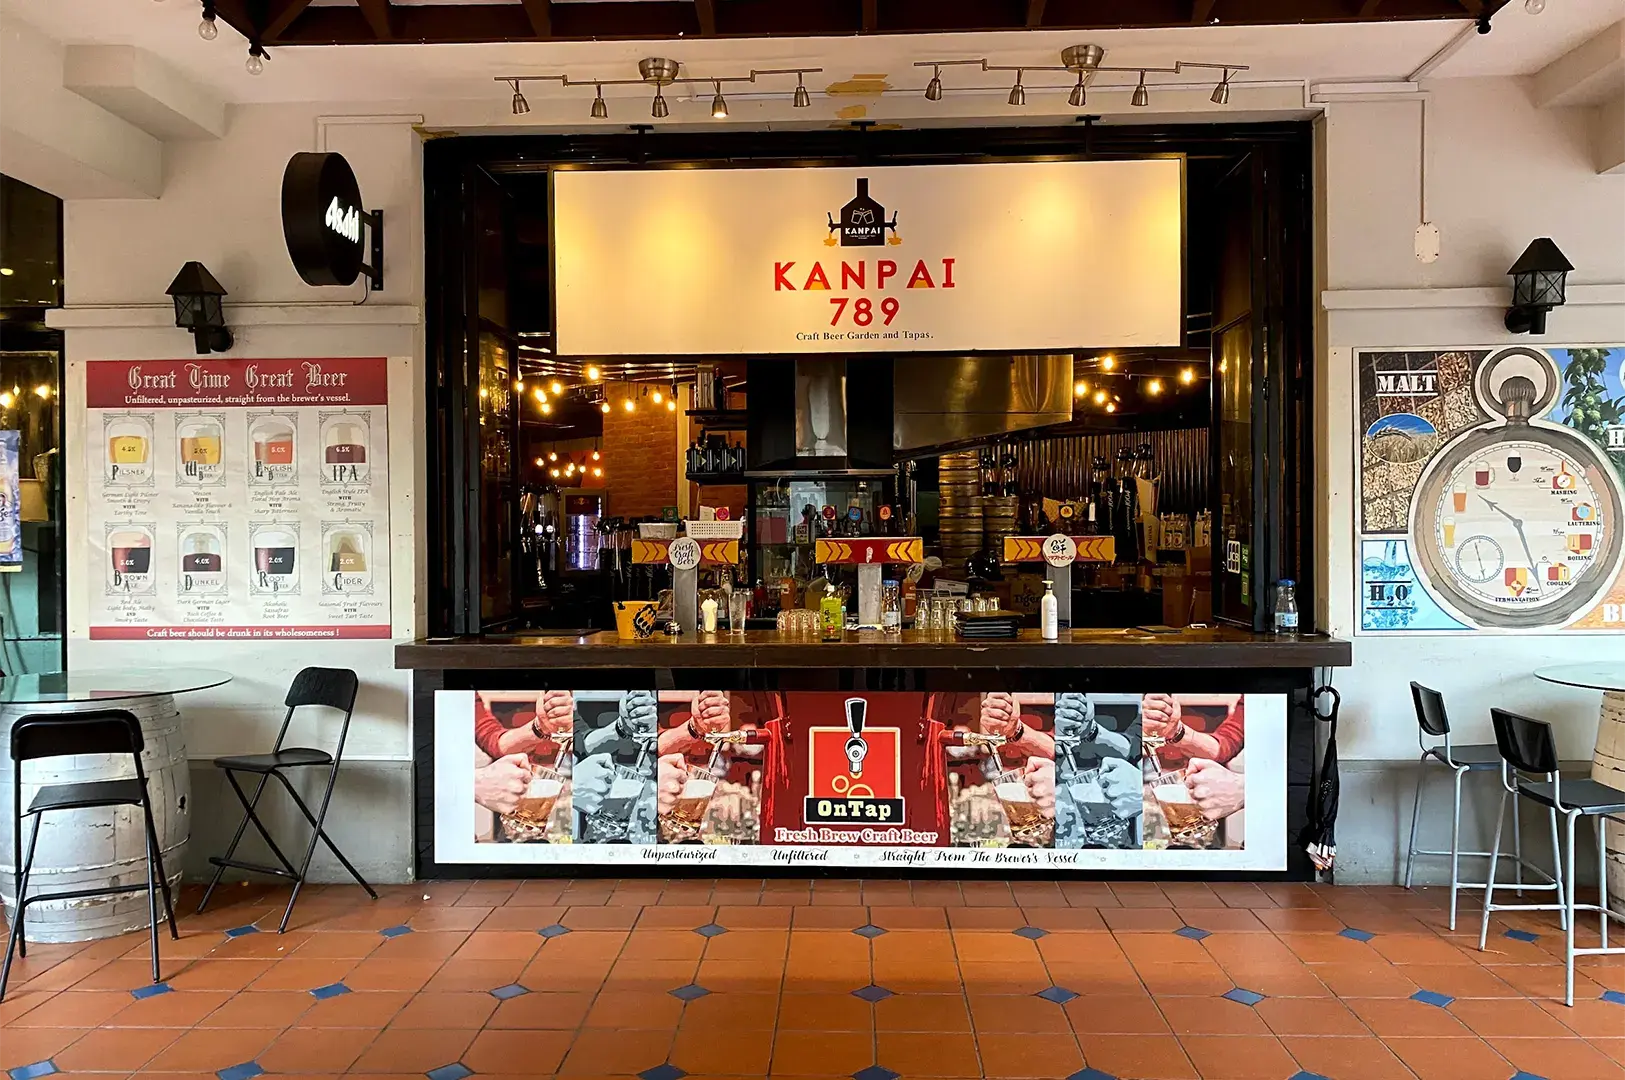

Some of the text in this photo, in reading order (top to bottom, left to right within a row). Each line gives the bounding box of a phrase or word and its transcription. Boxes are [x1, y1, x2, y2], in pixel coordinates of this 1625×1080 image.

[326, 196, 359, 244] Asahi
[844, 227, 880, 235] KANPAI
[774, 258, 956, 290] KANPAI
[830, 297, 900, 326] 789
[796, 330, 934, 341] Craft Beer Garden and Tapas.
[128, 362, 348, 394] Great Time Great Beer
[1378, 375, 1436, 392] MALT
[124, 392, 351, 406] Unfiltered, unpasteurized, straight from the brewer's vessel.
[333, 465, 358, 481] IPA
[673, 542, 694, 552] Fresh
[674, 549, 694, 561] Craft
[677, 557, 695, 566] Beer
[334, 572, 363, 591] CIDER
[146, 628, 168, 638] Craft
[170, 628, 187, 638] beer
[188, 628, 214, 638] should
[216, 628, 226, 638] be
[227, 628, 252, 637] drunk
[253, 628, 262, 637] in
[263, 628, 274, 637] its
[275, 628, 335, 637] wholesomeness
[817, 800, 892, 820] OnTap
[774, 827, 938, 844] Fresh Brew Craft Beer
[641, 848, 718, 862] Unpasteurized
[770, 848, 829, 864] Unfiltered
[881, 850, 1079, 864] Straight From The Brewer's Vessel
